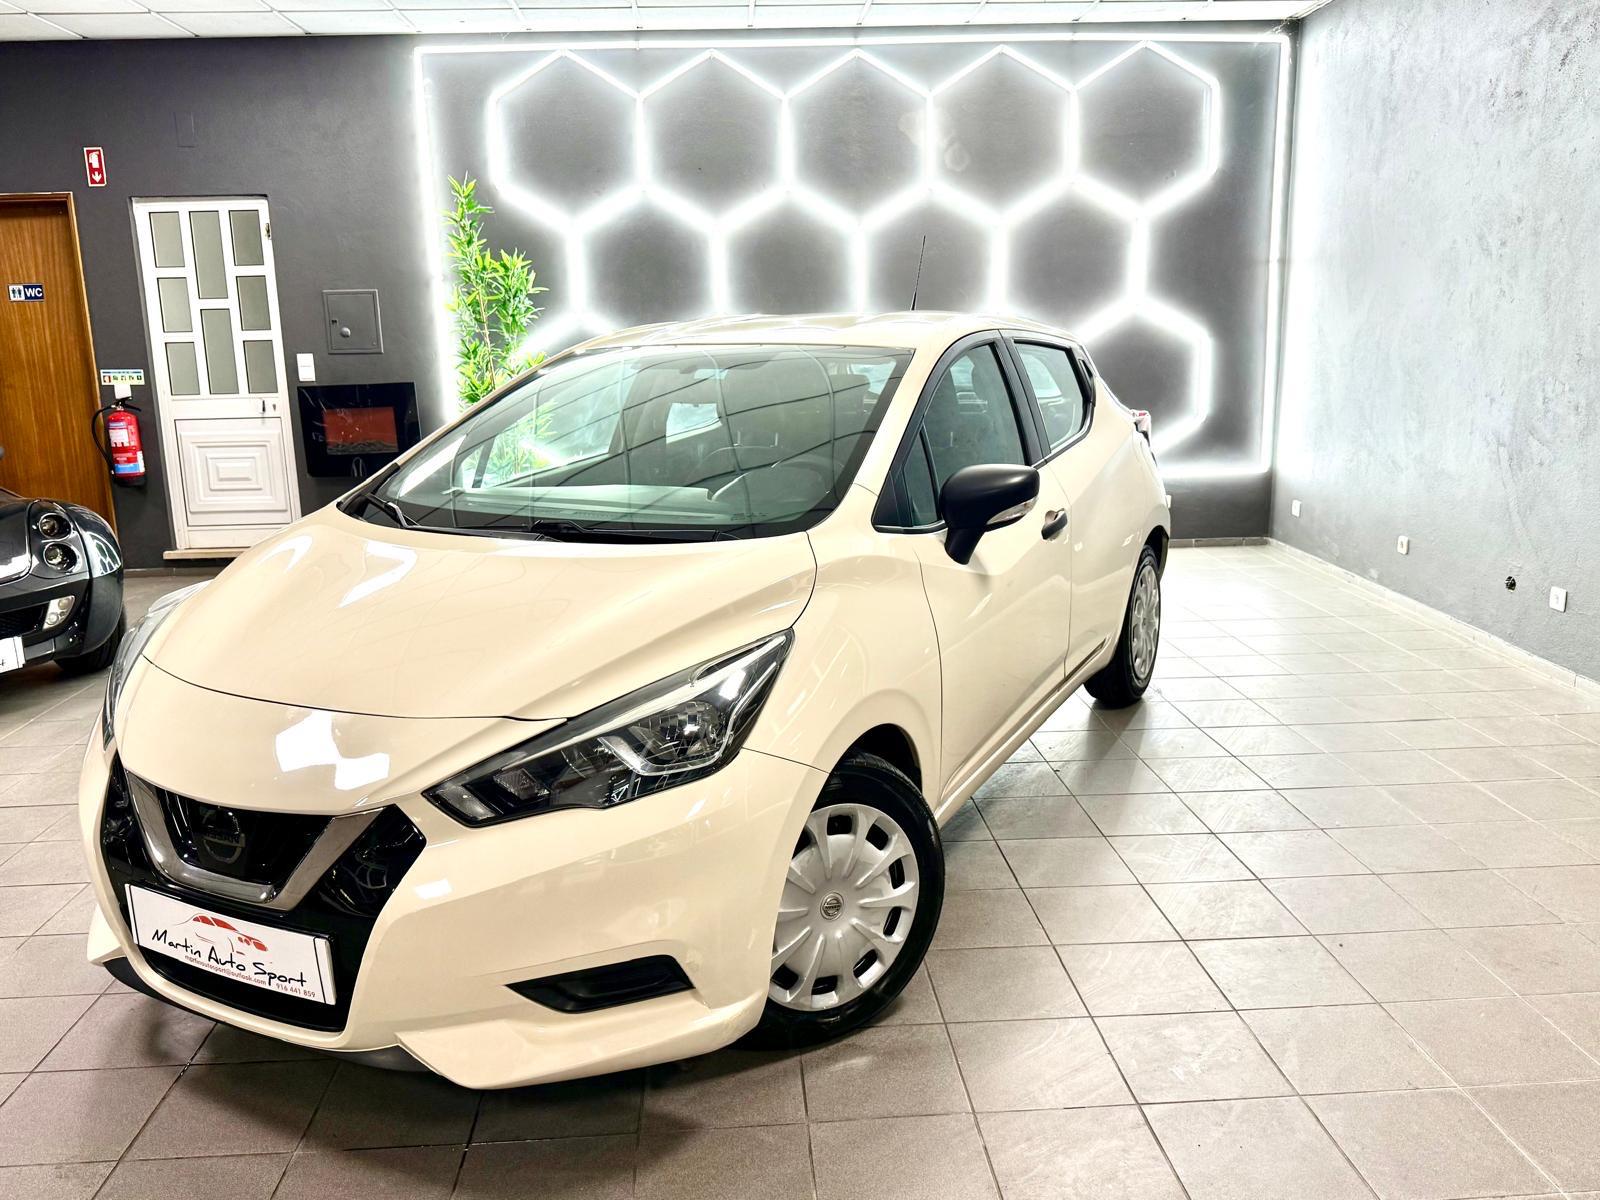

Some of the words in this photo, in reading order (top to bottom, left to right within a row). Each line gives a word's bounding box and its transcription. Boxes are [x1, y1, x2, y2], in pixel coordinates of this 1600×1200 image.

[25, 288, 43, 297] WC
[152, 929, 201, 958] Martin
[208, 945, 246, 971] Auto
[252, 962, 307, 986] Sport
[275, 982, 288, 992] 916
[303, 988, 316, 998] 859
